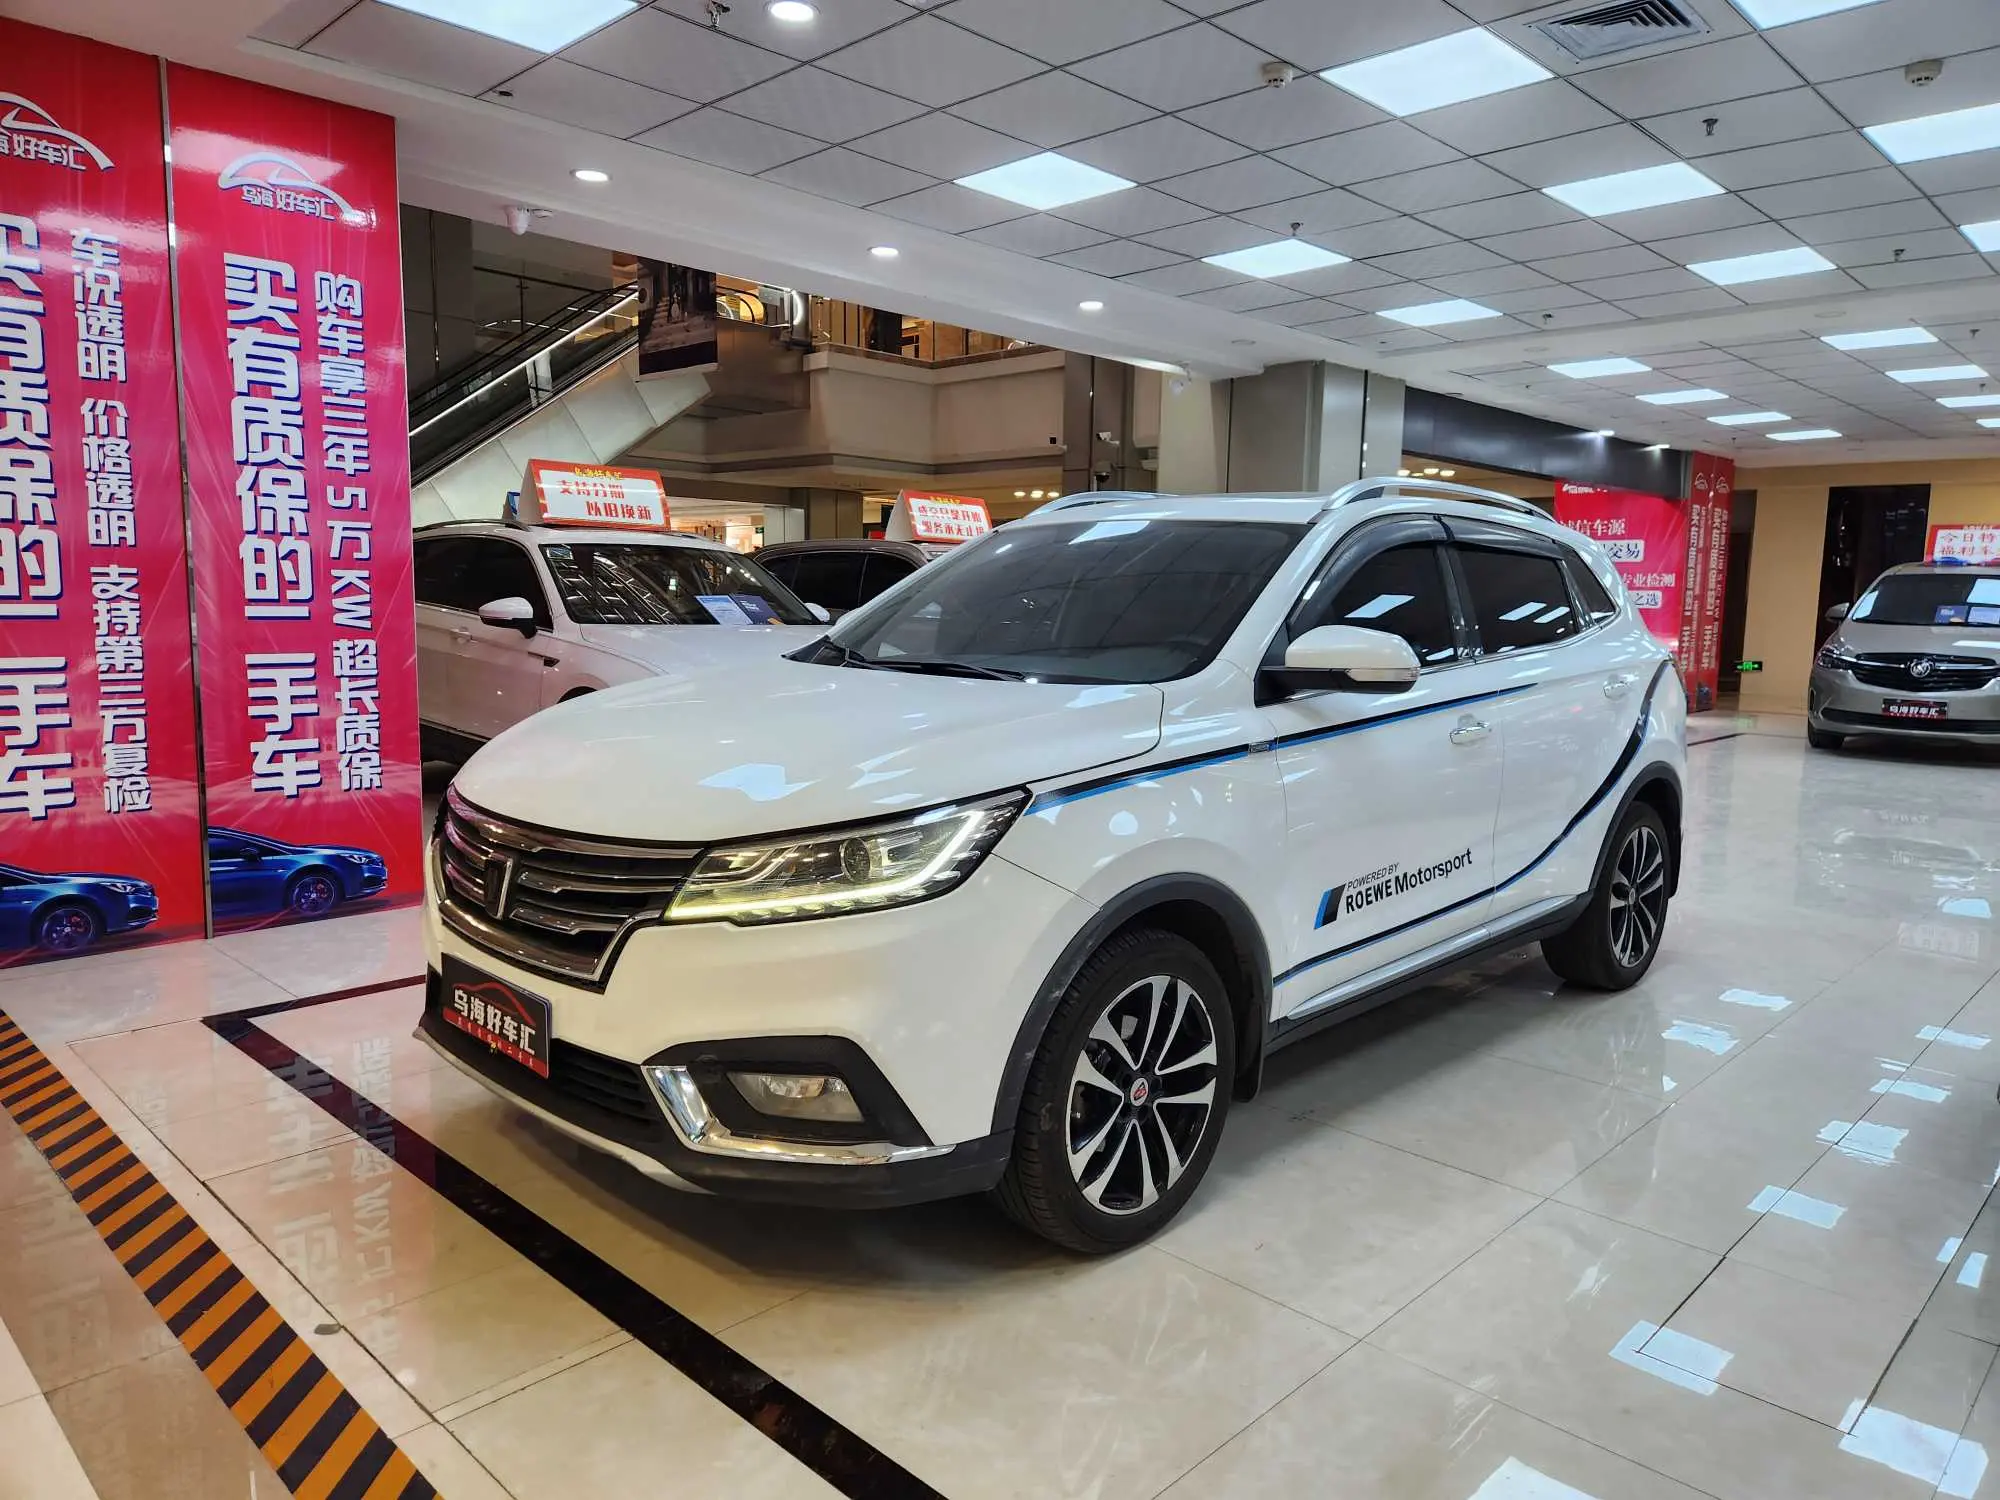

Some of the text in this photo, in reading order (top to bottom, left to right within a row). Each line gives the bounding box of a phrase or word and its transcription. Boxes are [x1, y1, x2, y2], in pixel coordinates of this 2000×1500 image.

[71, 228, 152, 814] 车况透明 价格透明 支持第三方复检
[586, 500, 653, 521] 以旧换新
[1346, 847, 1473, 914] ROEWE Motorsport
[1347, 862, 1400, 892] POWERED BY
[454, 988, 537, 1055] 乌海好车汇
